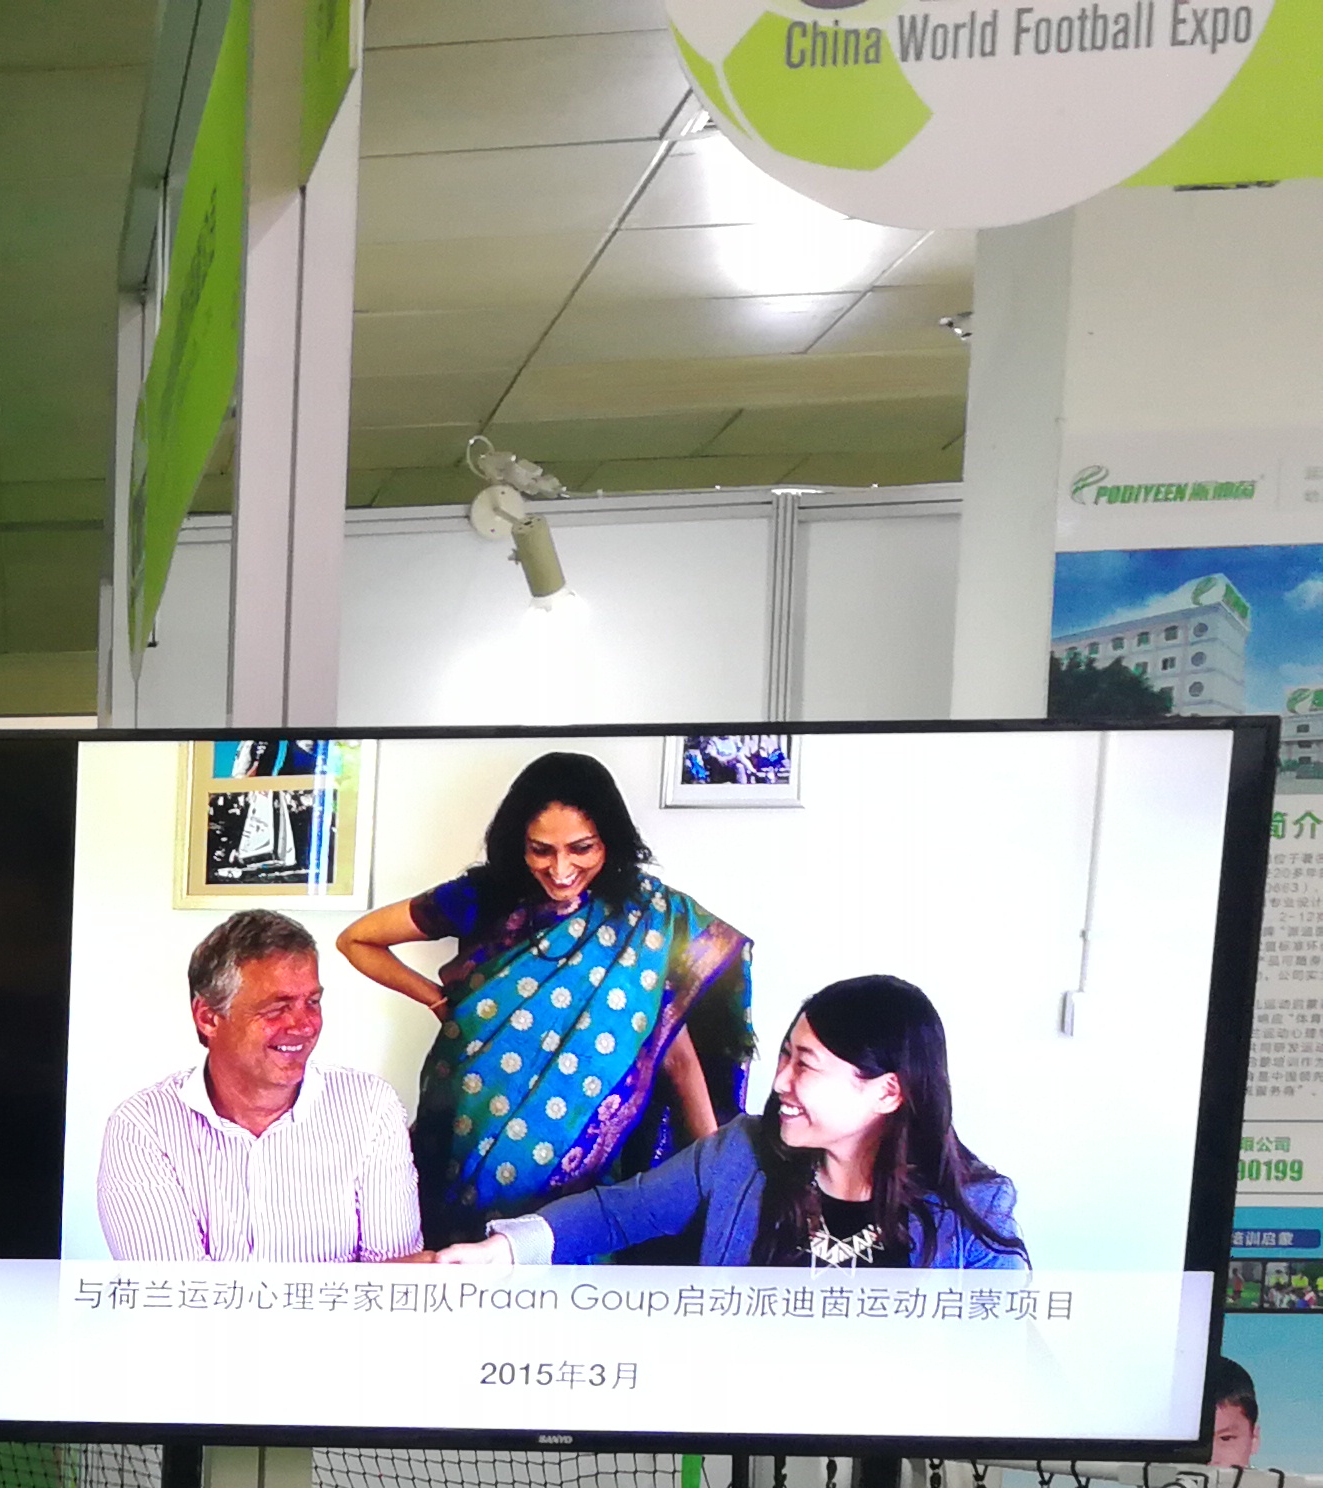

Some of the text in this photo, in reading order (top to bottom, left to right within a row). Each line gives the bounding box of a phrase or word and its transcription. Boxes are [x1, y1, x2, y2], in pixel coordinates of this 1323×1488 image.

[783, 1, 1252, 69] China World Football Expo
[479, 1358, 640, 1392] 2015年3月
